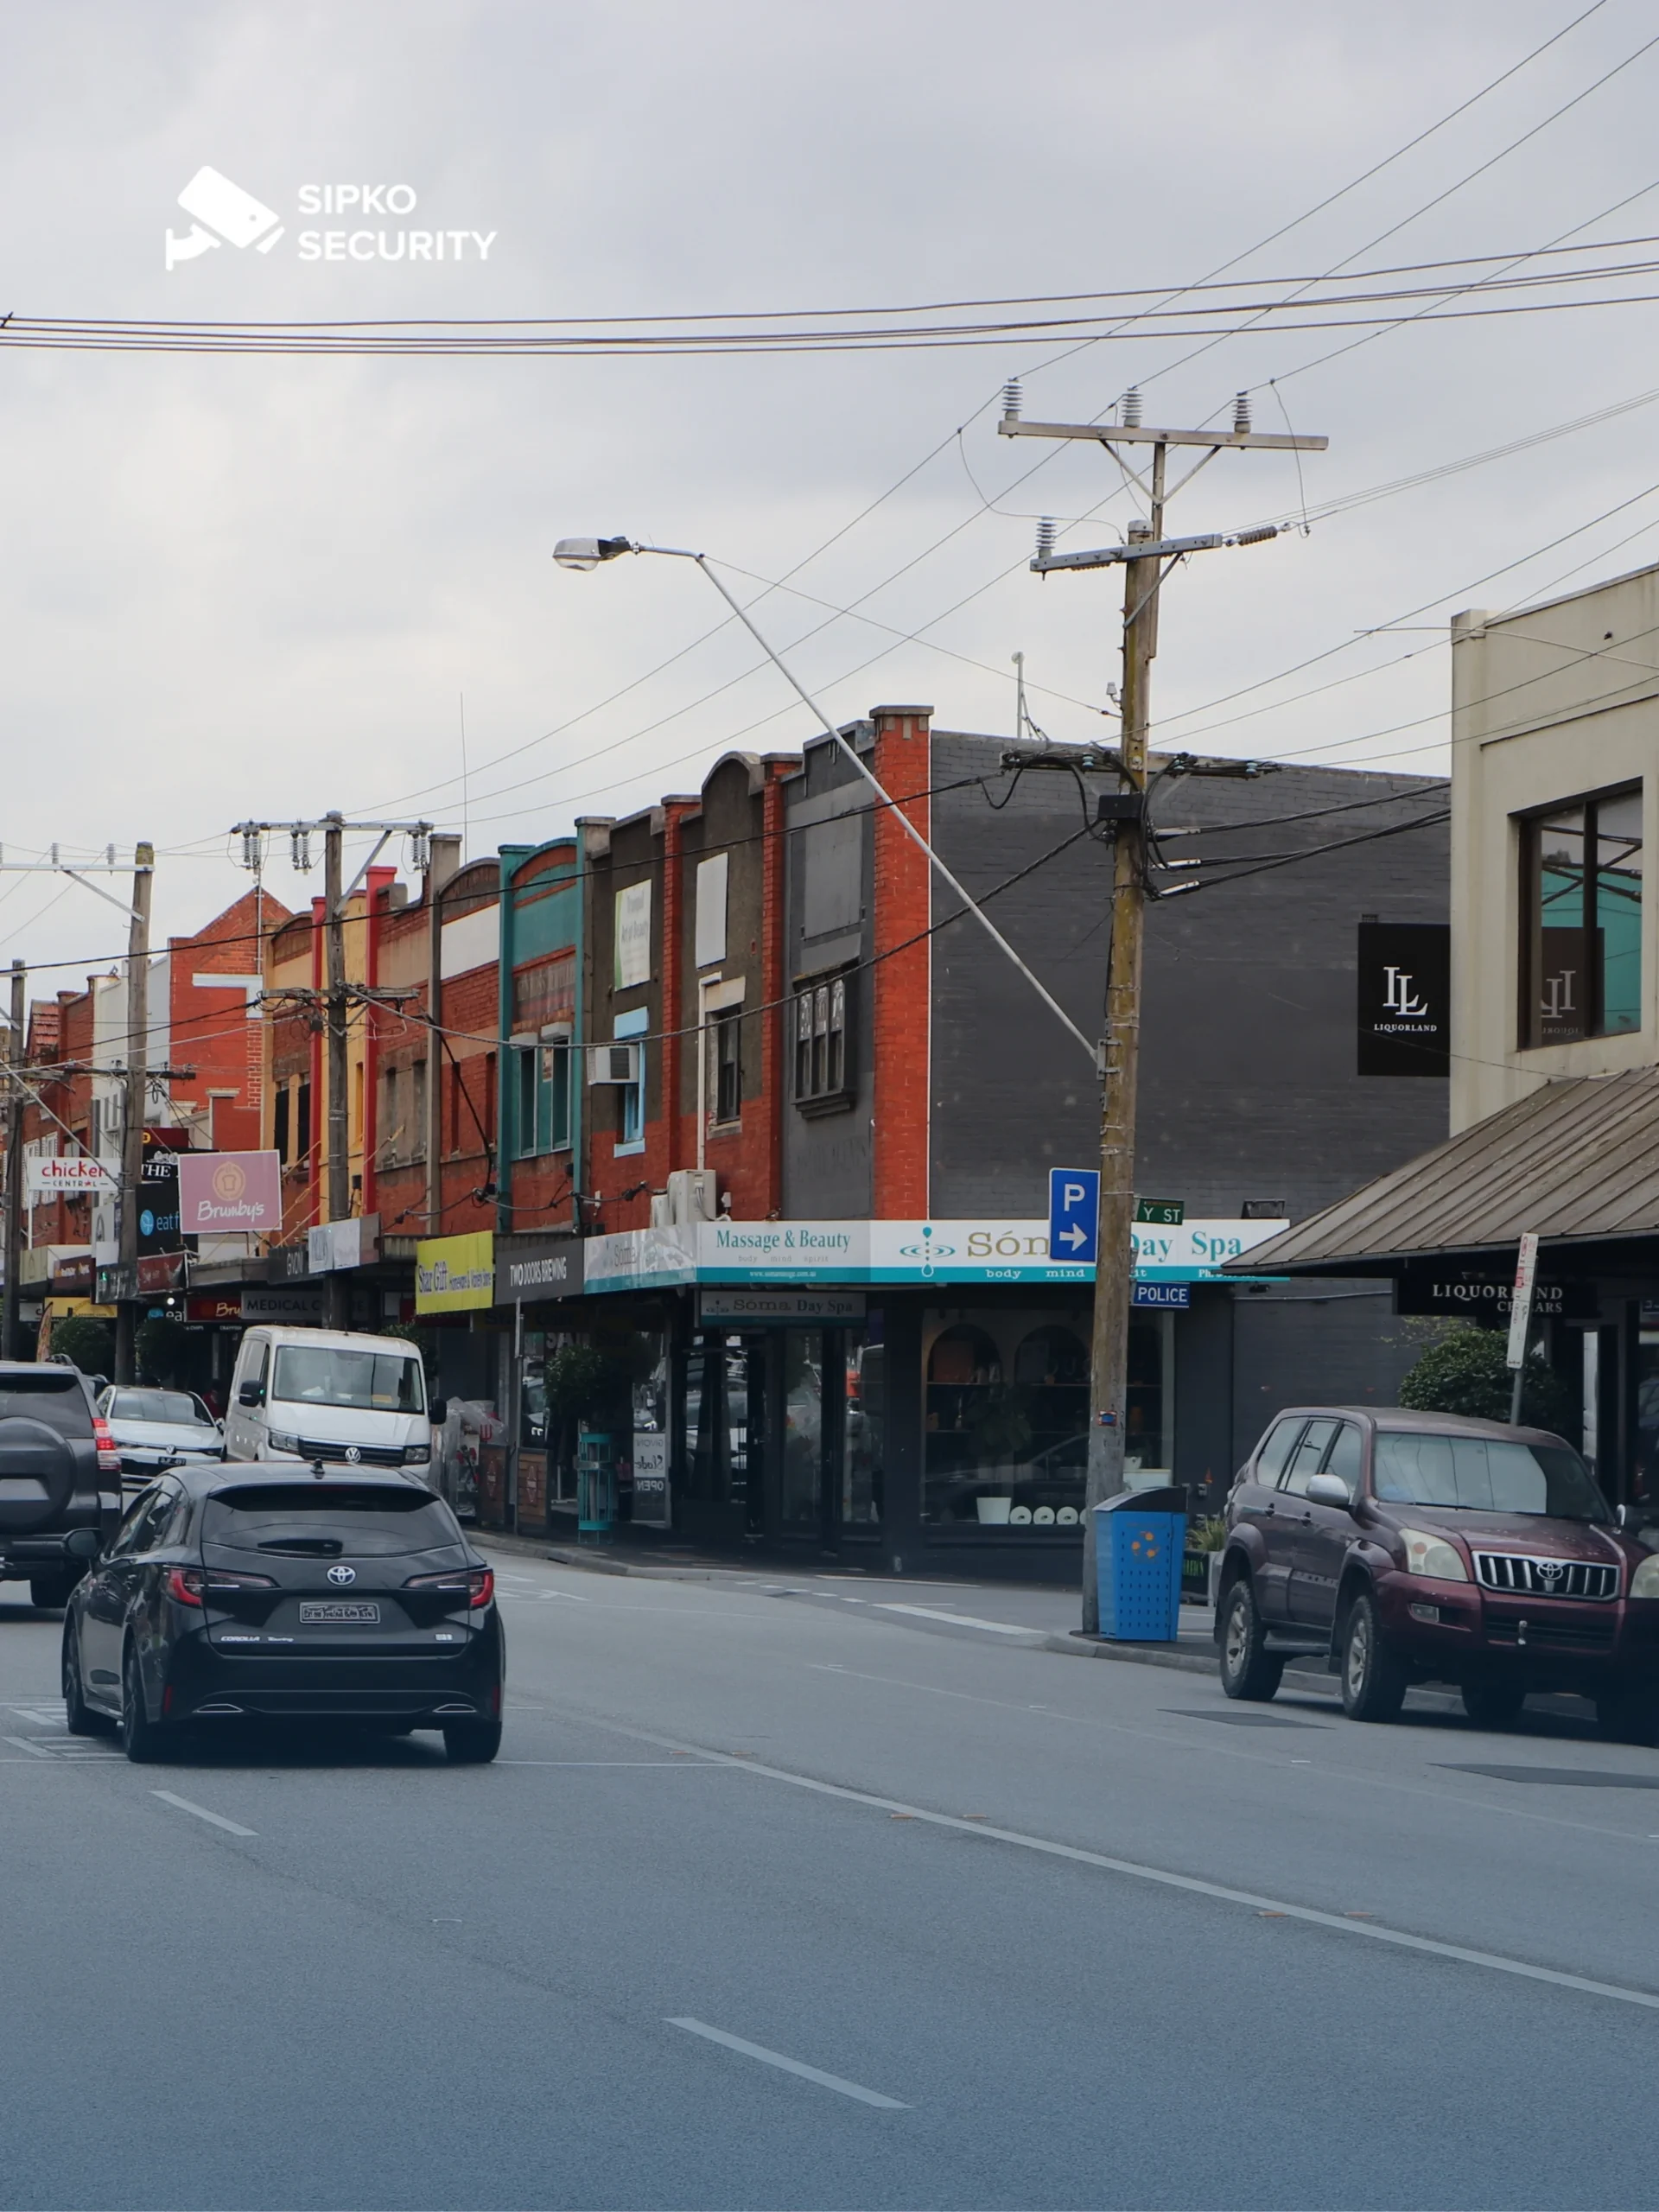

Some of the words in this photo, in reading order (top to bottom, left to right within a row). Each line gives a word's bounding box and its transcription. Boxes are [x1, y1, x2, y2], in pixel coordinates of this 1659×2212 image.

[1374, 1023, 1437, 1033] LIQUORLAND
[141, 1164, 171, 1178] THE
[1064, 1183, 1085, 1211] P
[197, 1199, 264, 1223] Brumby's
[1163, 1209, 1181, 1223] ST
[156, 1212, 173, 1230] eat
[716, 1230, 780, 1253] Massage
[785, 1230, 796, 1248] &
[799, 1230, 851, 1253] Beauty
[1191, 1230, 1243, 1262] Spa
[418, 1264, 433, 1294] Star
[434, 1261, 448, 1291] Gift
[510, 1263, 523, 1287] TWO
[541, 1256, 567, 1283] BREWING
[986, 1268, 1021, 1279] body
[1046, 1268, 1085, 1278] mind
[1138, 1287, 1187, 1302] POLICE
[1432, 1284, 1563, 1301] LIQUORND
[246, 1299, 308, 1311] MEDICAL
[797, 1300, 823, 1314] Day
[827, 1300, 854, 1314] Spa
[1497, 1300, 1563, 1313] CEARS
